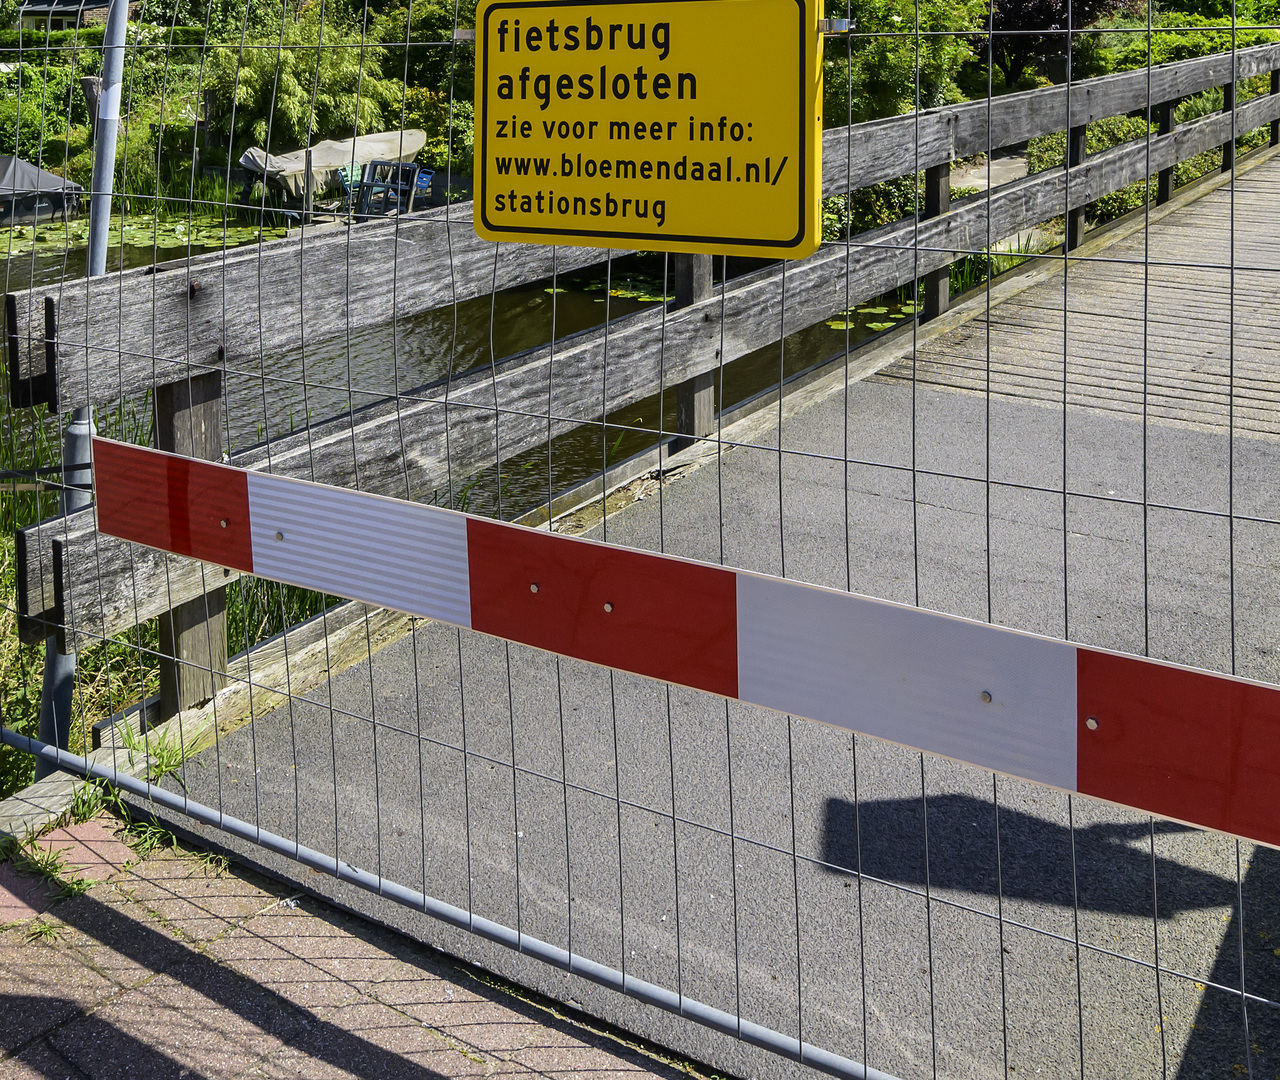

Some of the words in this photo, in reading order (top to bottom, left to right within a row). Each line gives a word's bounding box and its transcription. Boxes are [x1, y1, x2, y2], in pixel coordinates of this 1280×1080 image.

[497, 15, 670, 61] fietsbrug
[497, 65, 697, 111] afgesloten
[495, 115, 533, 139] zie
[542, 120, 599, 140] voor
[609, 121, 678, 141] meer
[689, 115, 753, 142] info:
[495, 152, 789, 186] www.bloemendaal.nl/
[494, 189, 666, 228] stationsbrug
